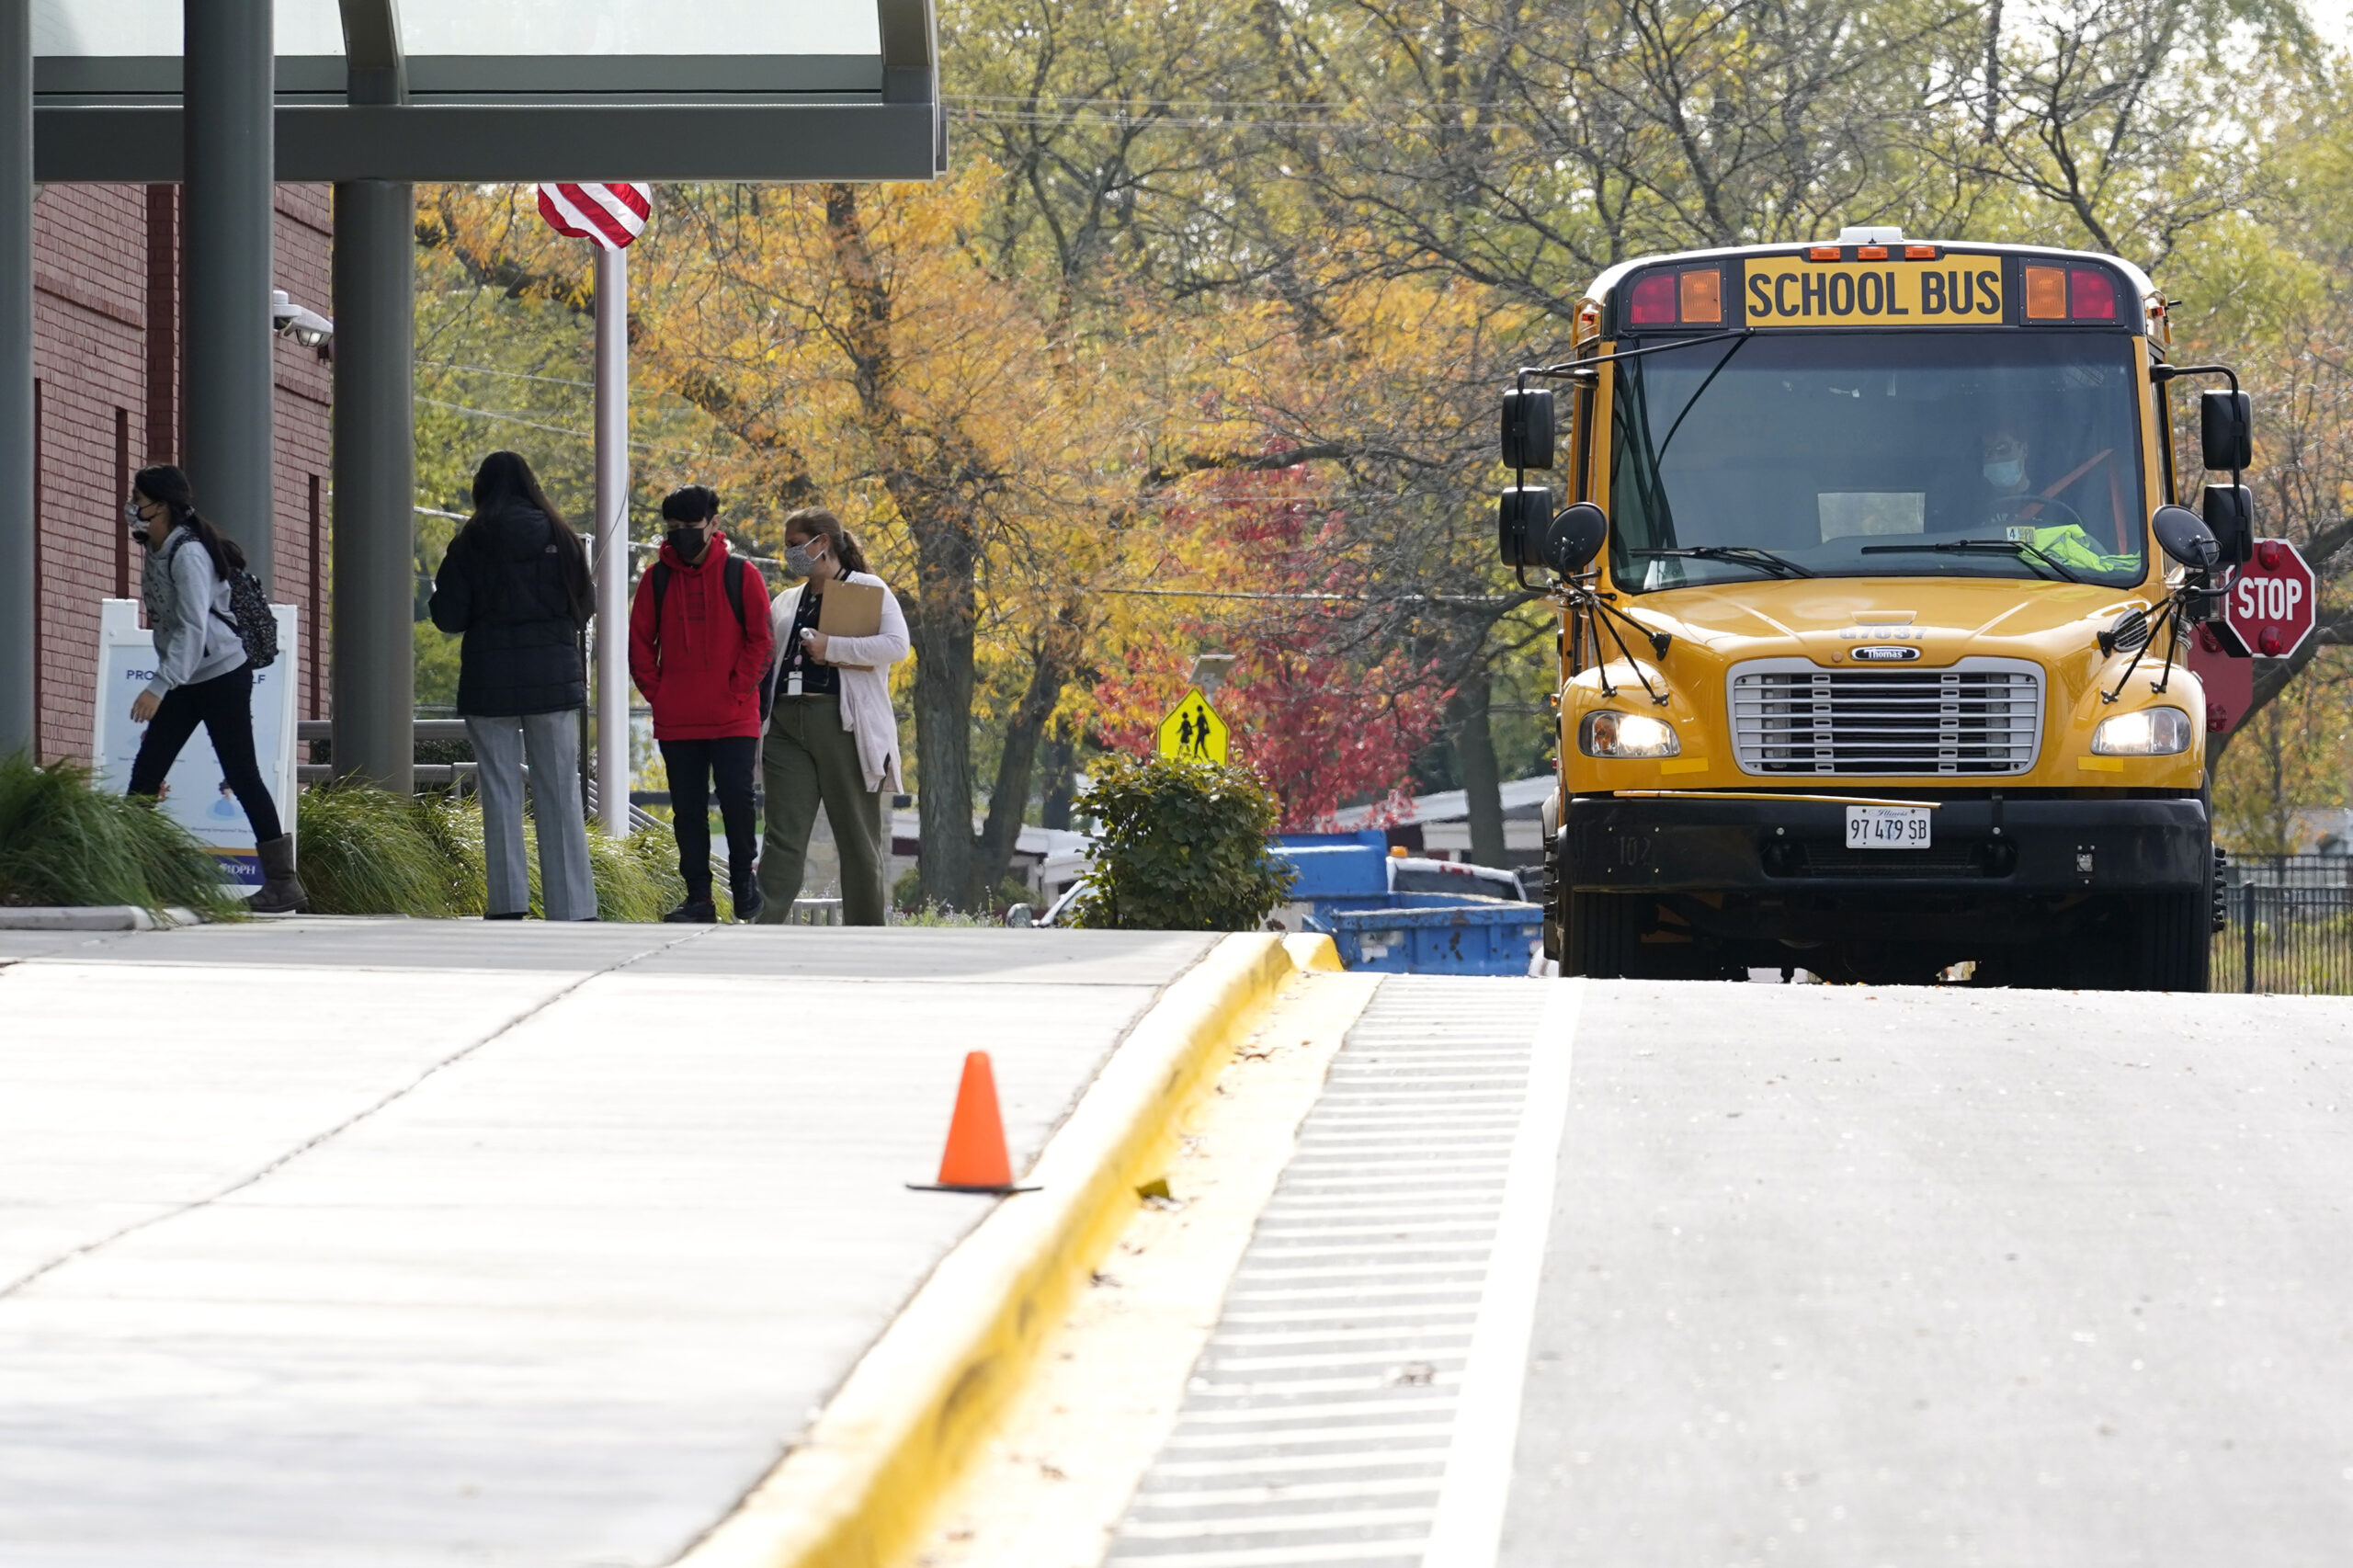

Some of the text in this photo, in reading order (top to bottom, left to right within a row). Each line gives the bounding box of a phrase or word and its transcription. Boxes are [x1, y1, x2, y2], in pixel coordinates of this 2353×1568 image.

[1747, 270, 2001, 317] SCHOOL BUS
[2237, 576, 2302, 621] STOP
[1864, 647, 1907, 659] Thomas
[1878, 809, 1908, 817] Illinois
[1851, 819, 1927, 840] 97 479 SB
